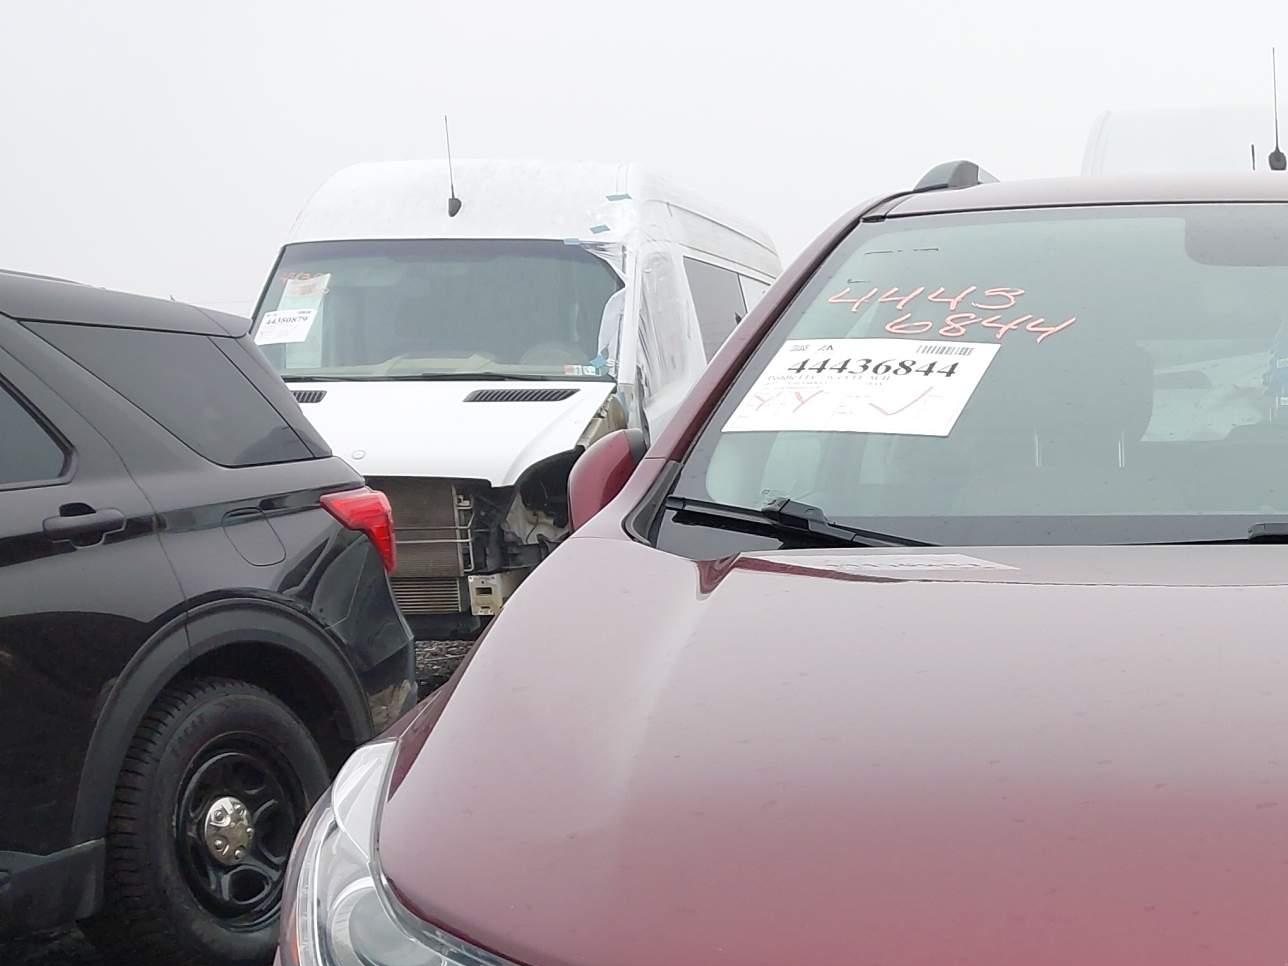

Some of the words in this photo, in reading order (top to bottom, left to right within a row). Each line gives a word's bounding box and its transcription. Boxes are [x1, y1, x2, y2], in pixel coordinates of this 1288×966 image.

[828, 286, 1025, 311] 4443
[885, 313, 1076, 344] 6844
[787, 357, 960, 378] 44436844
